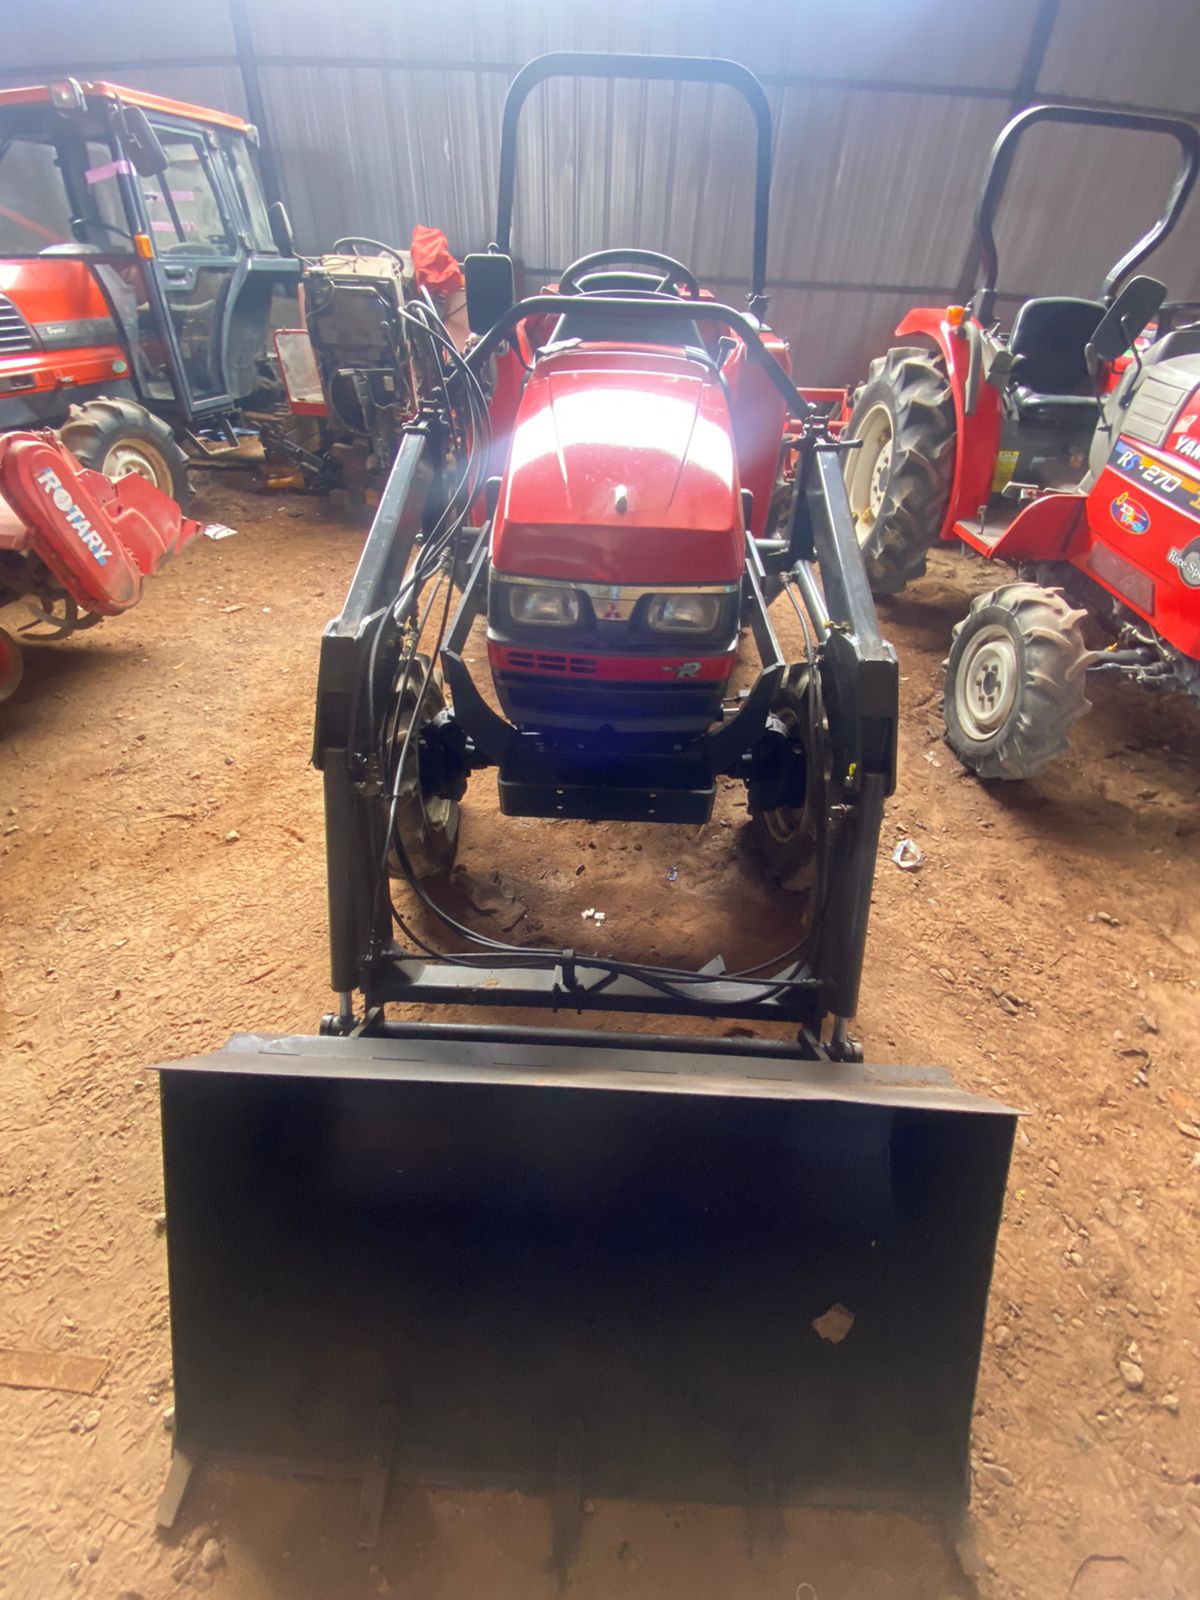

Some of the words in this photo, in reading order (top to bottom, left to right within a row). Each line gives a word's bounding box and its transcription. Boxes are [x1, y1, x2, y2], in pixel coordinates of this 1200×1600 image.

[37, 467, 113, 564] ROTARY
[1168, 549, 1187, 568] Rice
[1185, 561, 1200, 578] Sp
